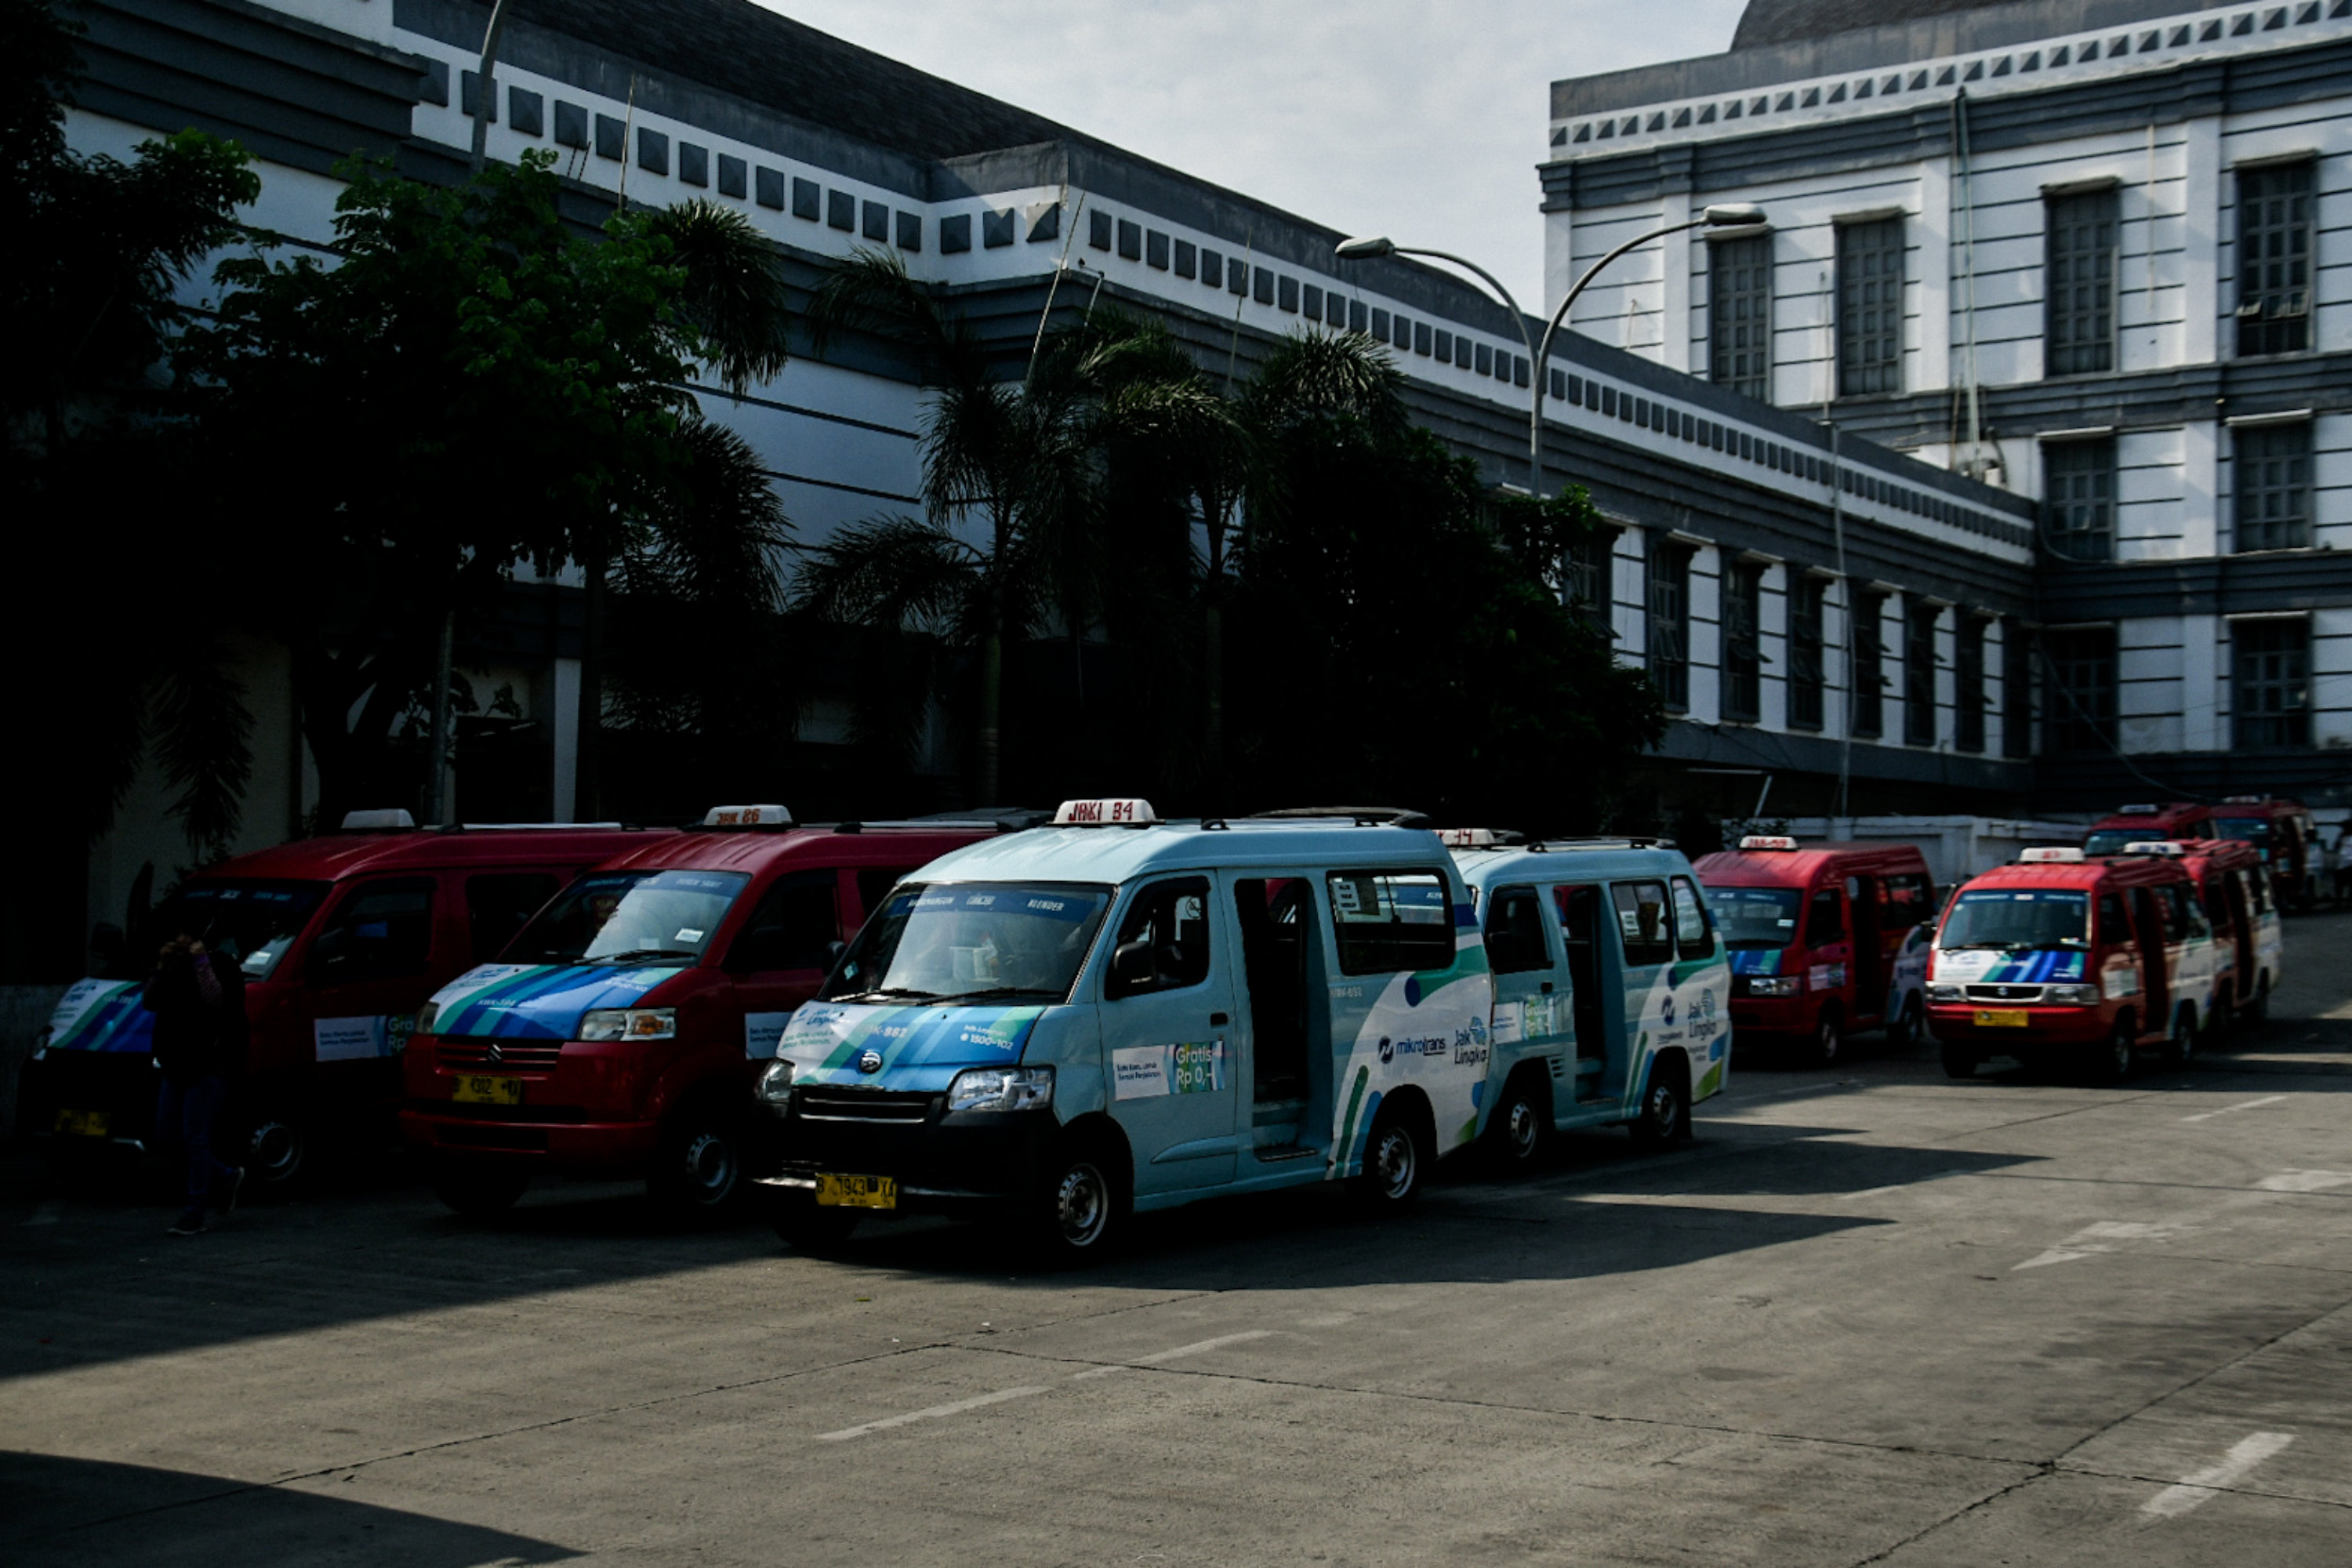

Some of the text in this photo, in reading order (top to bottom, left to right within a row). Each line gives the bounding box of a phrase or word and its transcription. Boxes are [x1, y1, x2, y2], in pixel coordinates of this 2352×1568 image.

[1027, 898, 1065, 912] KLENDER
[1396, 1036, 1446, 1055] mikrotrans
[1454, 1029, 1471, 1045] Jak
[1176, 1045, 1212, 1065] Gratis
[1454, 1047, 1488, 1067] Lingko
[1177, 1069, 1192, 1089] Rp
[817, 1177, 825, 1194] B
